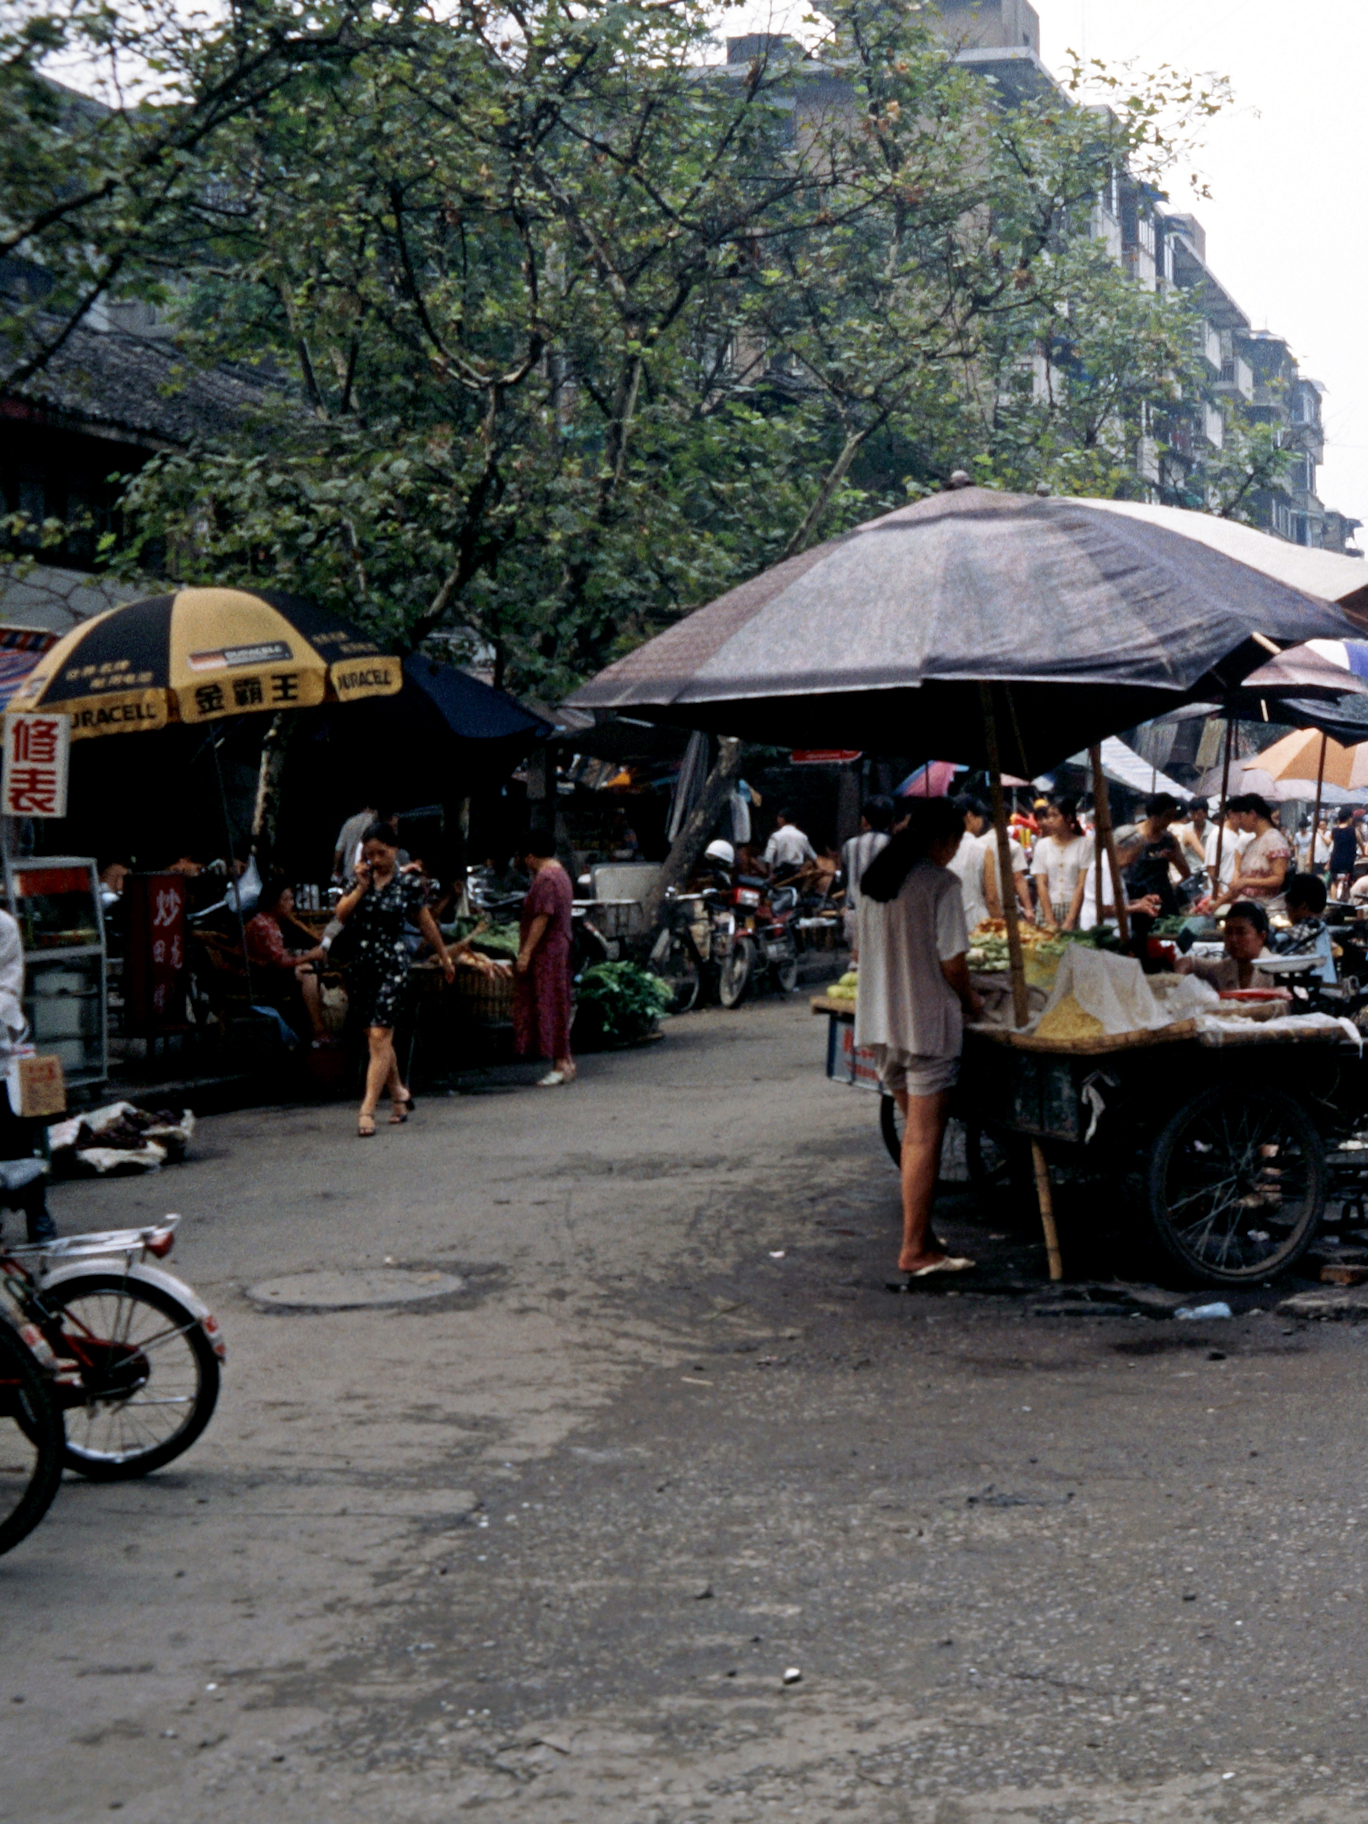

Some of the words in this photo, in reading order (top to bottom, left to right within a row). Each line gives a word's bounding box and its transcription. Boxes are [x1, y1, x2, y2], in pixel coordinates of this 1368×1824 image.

[195, 674, 299, 714] 金霸王
[8, 719, 59, 813] 修表
